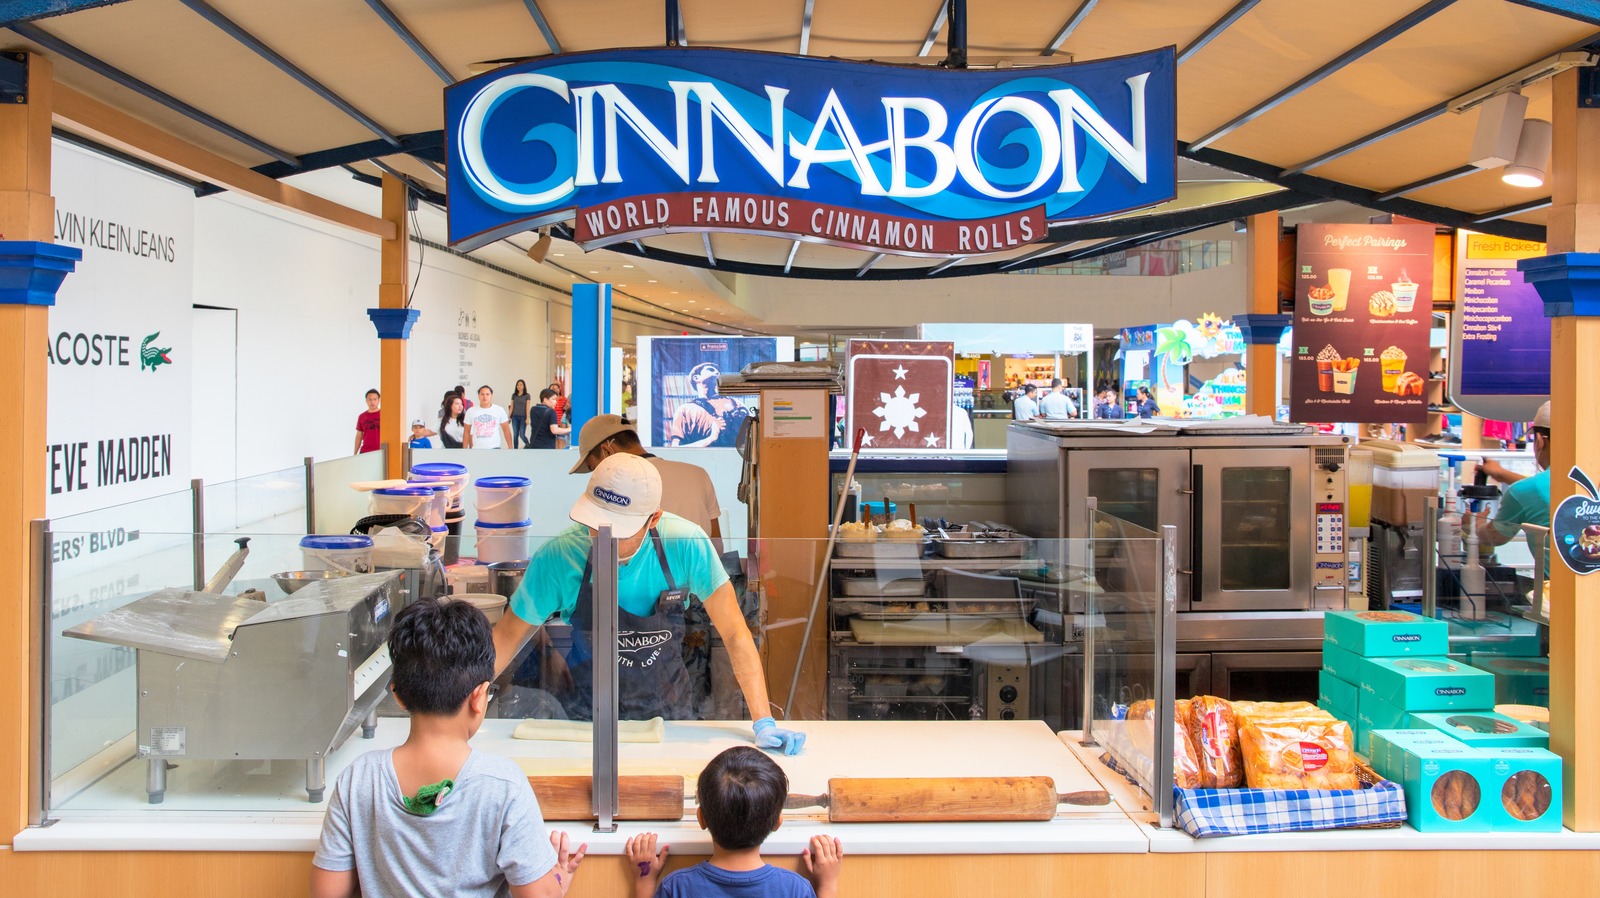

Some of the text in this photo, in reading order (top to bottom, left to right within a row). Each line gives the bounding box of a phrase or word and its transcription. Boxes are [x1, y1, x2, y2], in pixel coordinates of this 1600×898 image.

[457, 72, 1150, 205] CINNABON
[54, 209, 175, 263] VIN KLEIN JEANS
[585, 197, 1033, 250] WORLD FAMOUS CINNAMON ROLLS
[1324, 234, 1407, 251] Perfect Pairings
[1473, 241, 1500, 251] Fresh
[1504, 241, 1540, 252] Baked
[46, 434, 171, 495] EVE MADDEN
[595, 488, 629, 505] CINNABON
[90, 527, 126, 554] BLVD
